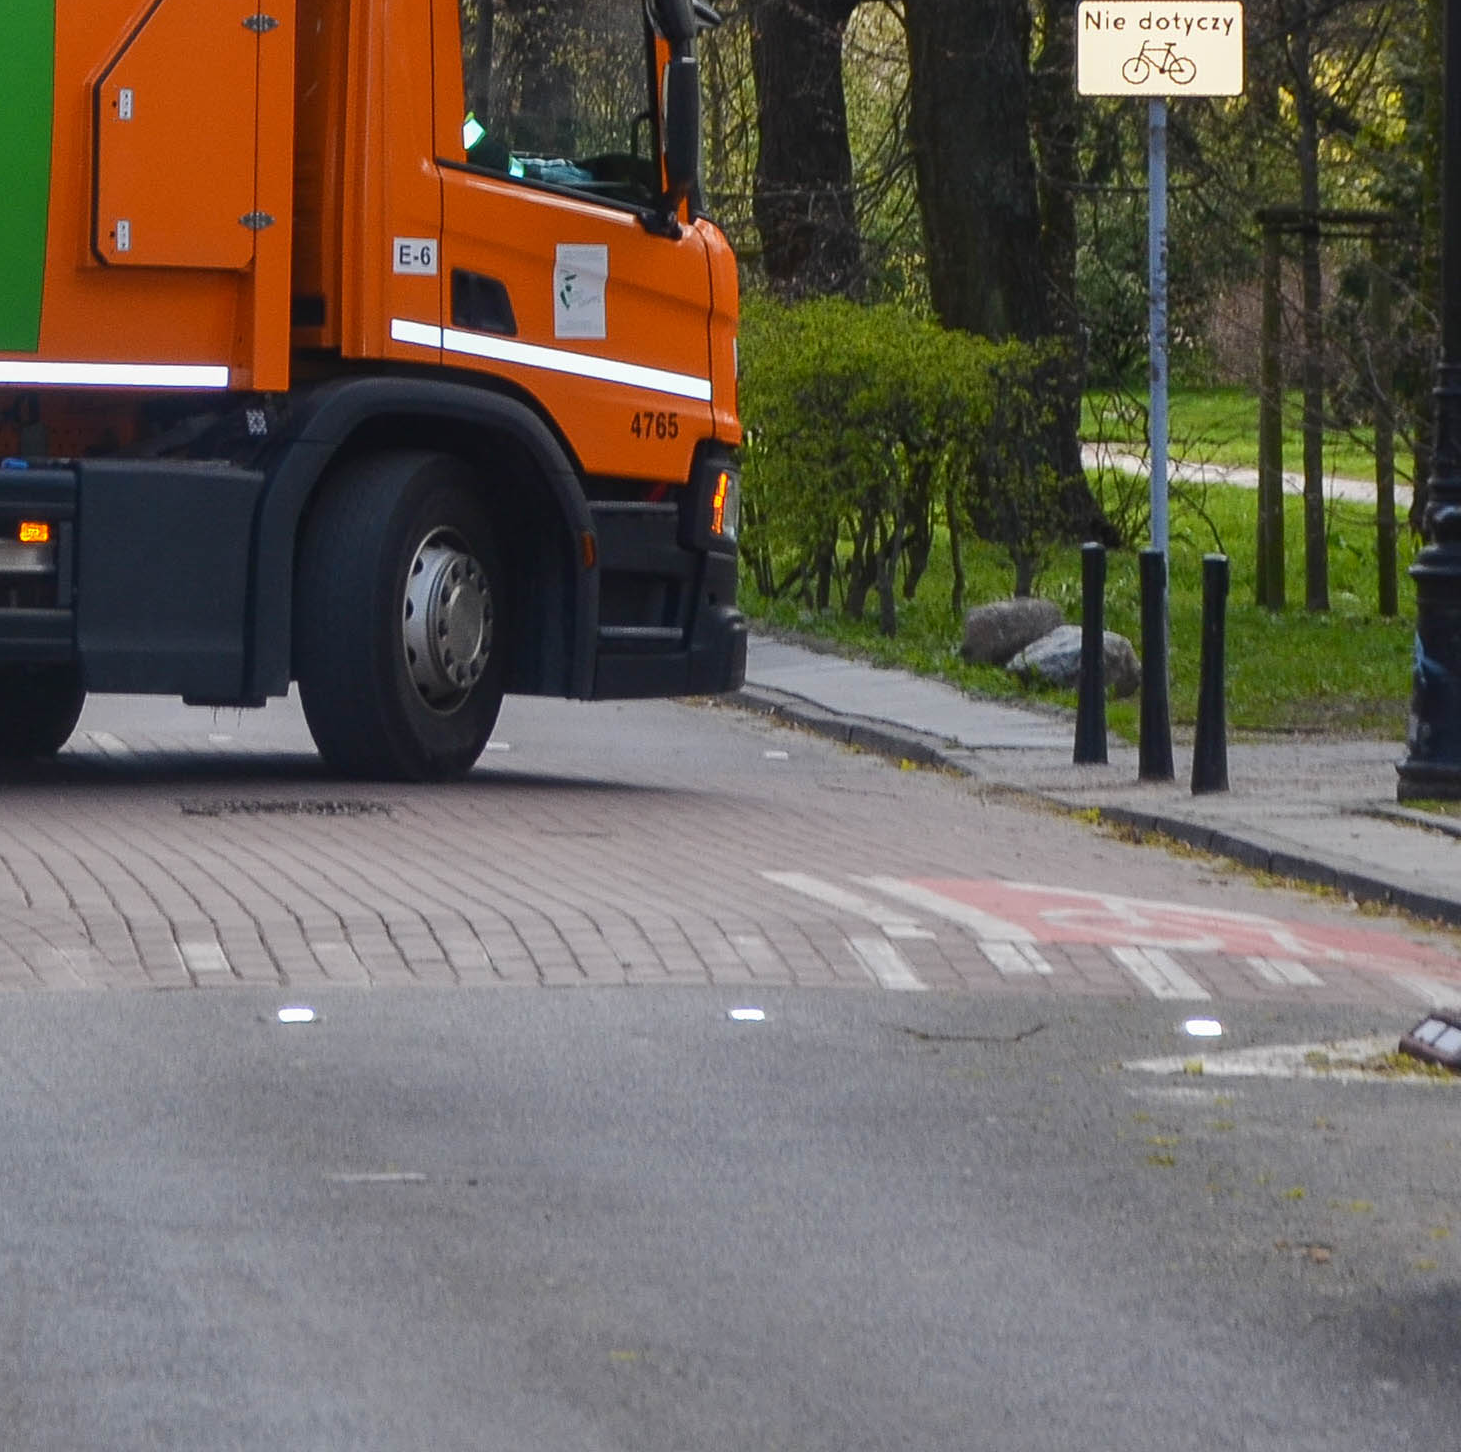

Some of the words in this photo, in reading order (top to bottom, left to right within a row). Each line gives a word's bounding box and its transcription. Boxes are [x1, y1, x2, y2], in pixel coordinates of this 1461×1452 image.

[1085, 11, 1126, 31] Nie
[1138, 11, 1234, 36] dotyczy
[399, 244, 431, 266] E-6
[631, 411, 679, 440] 4765
